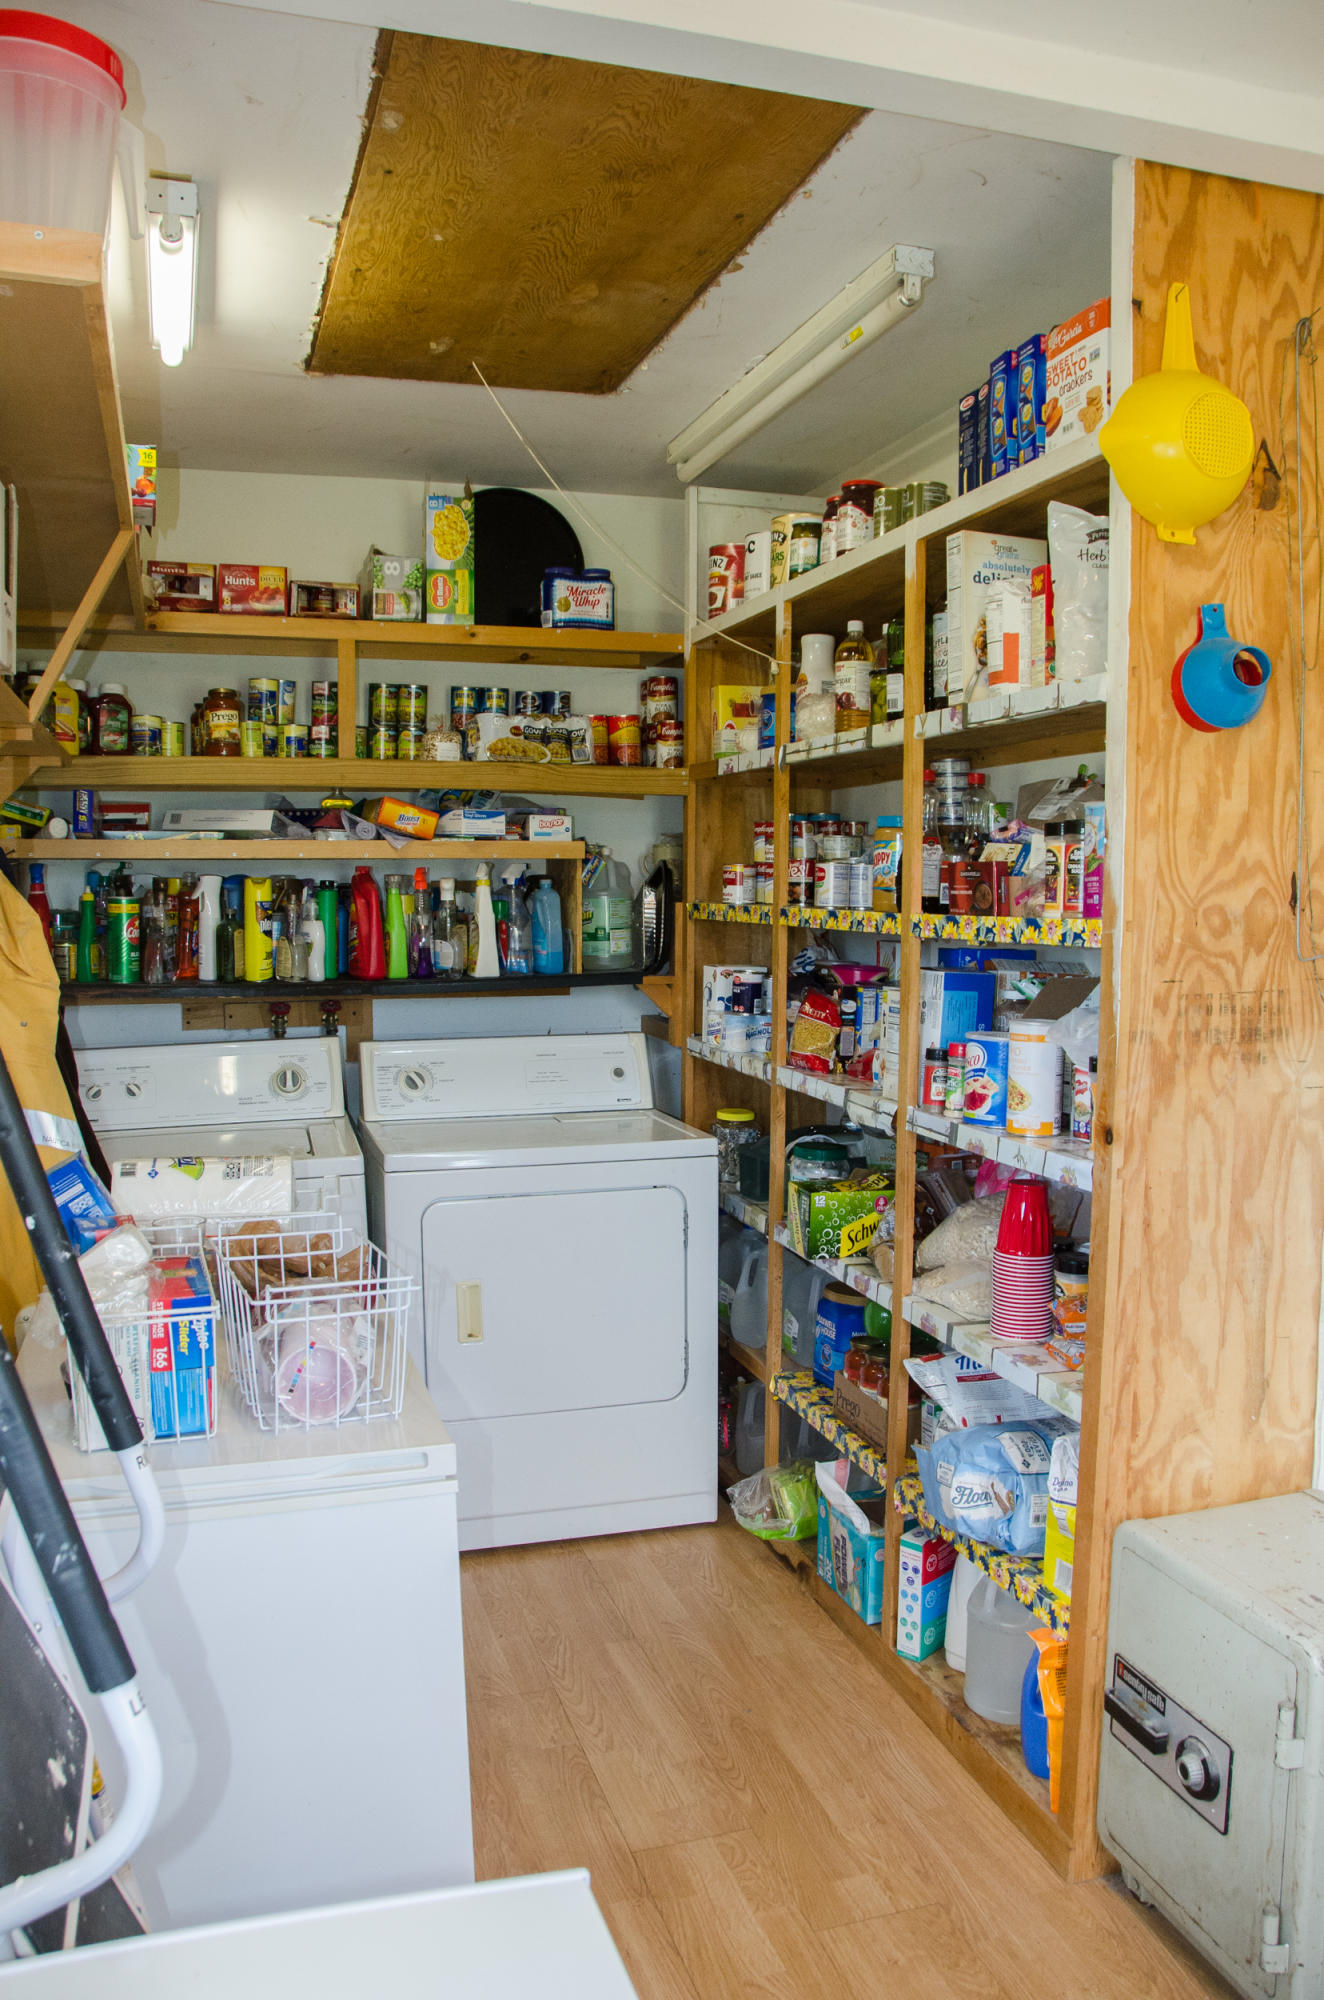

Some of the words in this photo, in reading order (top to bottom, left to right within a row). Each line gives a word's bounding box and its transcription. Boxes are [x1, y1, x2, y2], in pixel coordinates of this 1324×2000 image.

[1046, 351, 1075, 379] SWEET
[1046, 356, 1087, 389] POTATO
[1058, 370, 1093, 397] crackers
[142, 451, 153, 461] 16
[1076, 548, 1107, 562] Herb
[982, 560, 1032, 576] absolutely
[566, 583, 607, 598] Miracle
[572, 596, 601, 610] Whip
[210, 712, 239, 723] Prego
[814, 1195, 826, 1204] 12
[816, 1314, 837, 1332] MAXWELL
[178, 1319, 191, 1357] Slider
[821, 1326, 837, 1340] HOUSE
[156, 1346, 169, 1370] 166
[836, 1388, 860, 1418] Prego
[833, 1534, 841, 1575] FLEX
[840, 1533, 849, 1589] POWER
